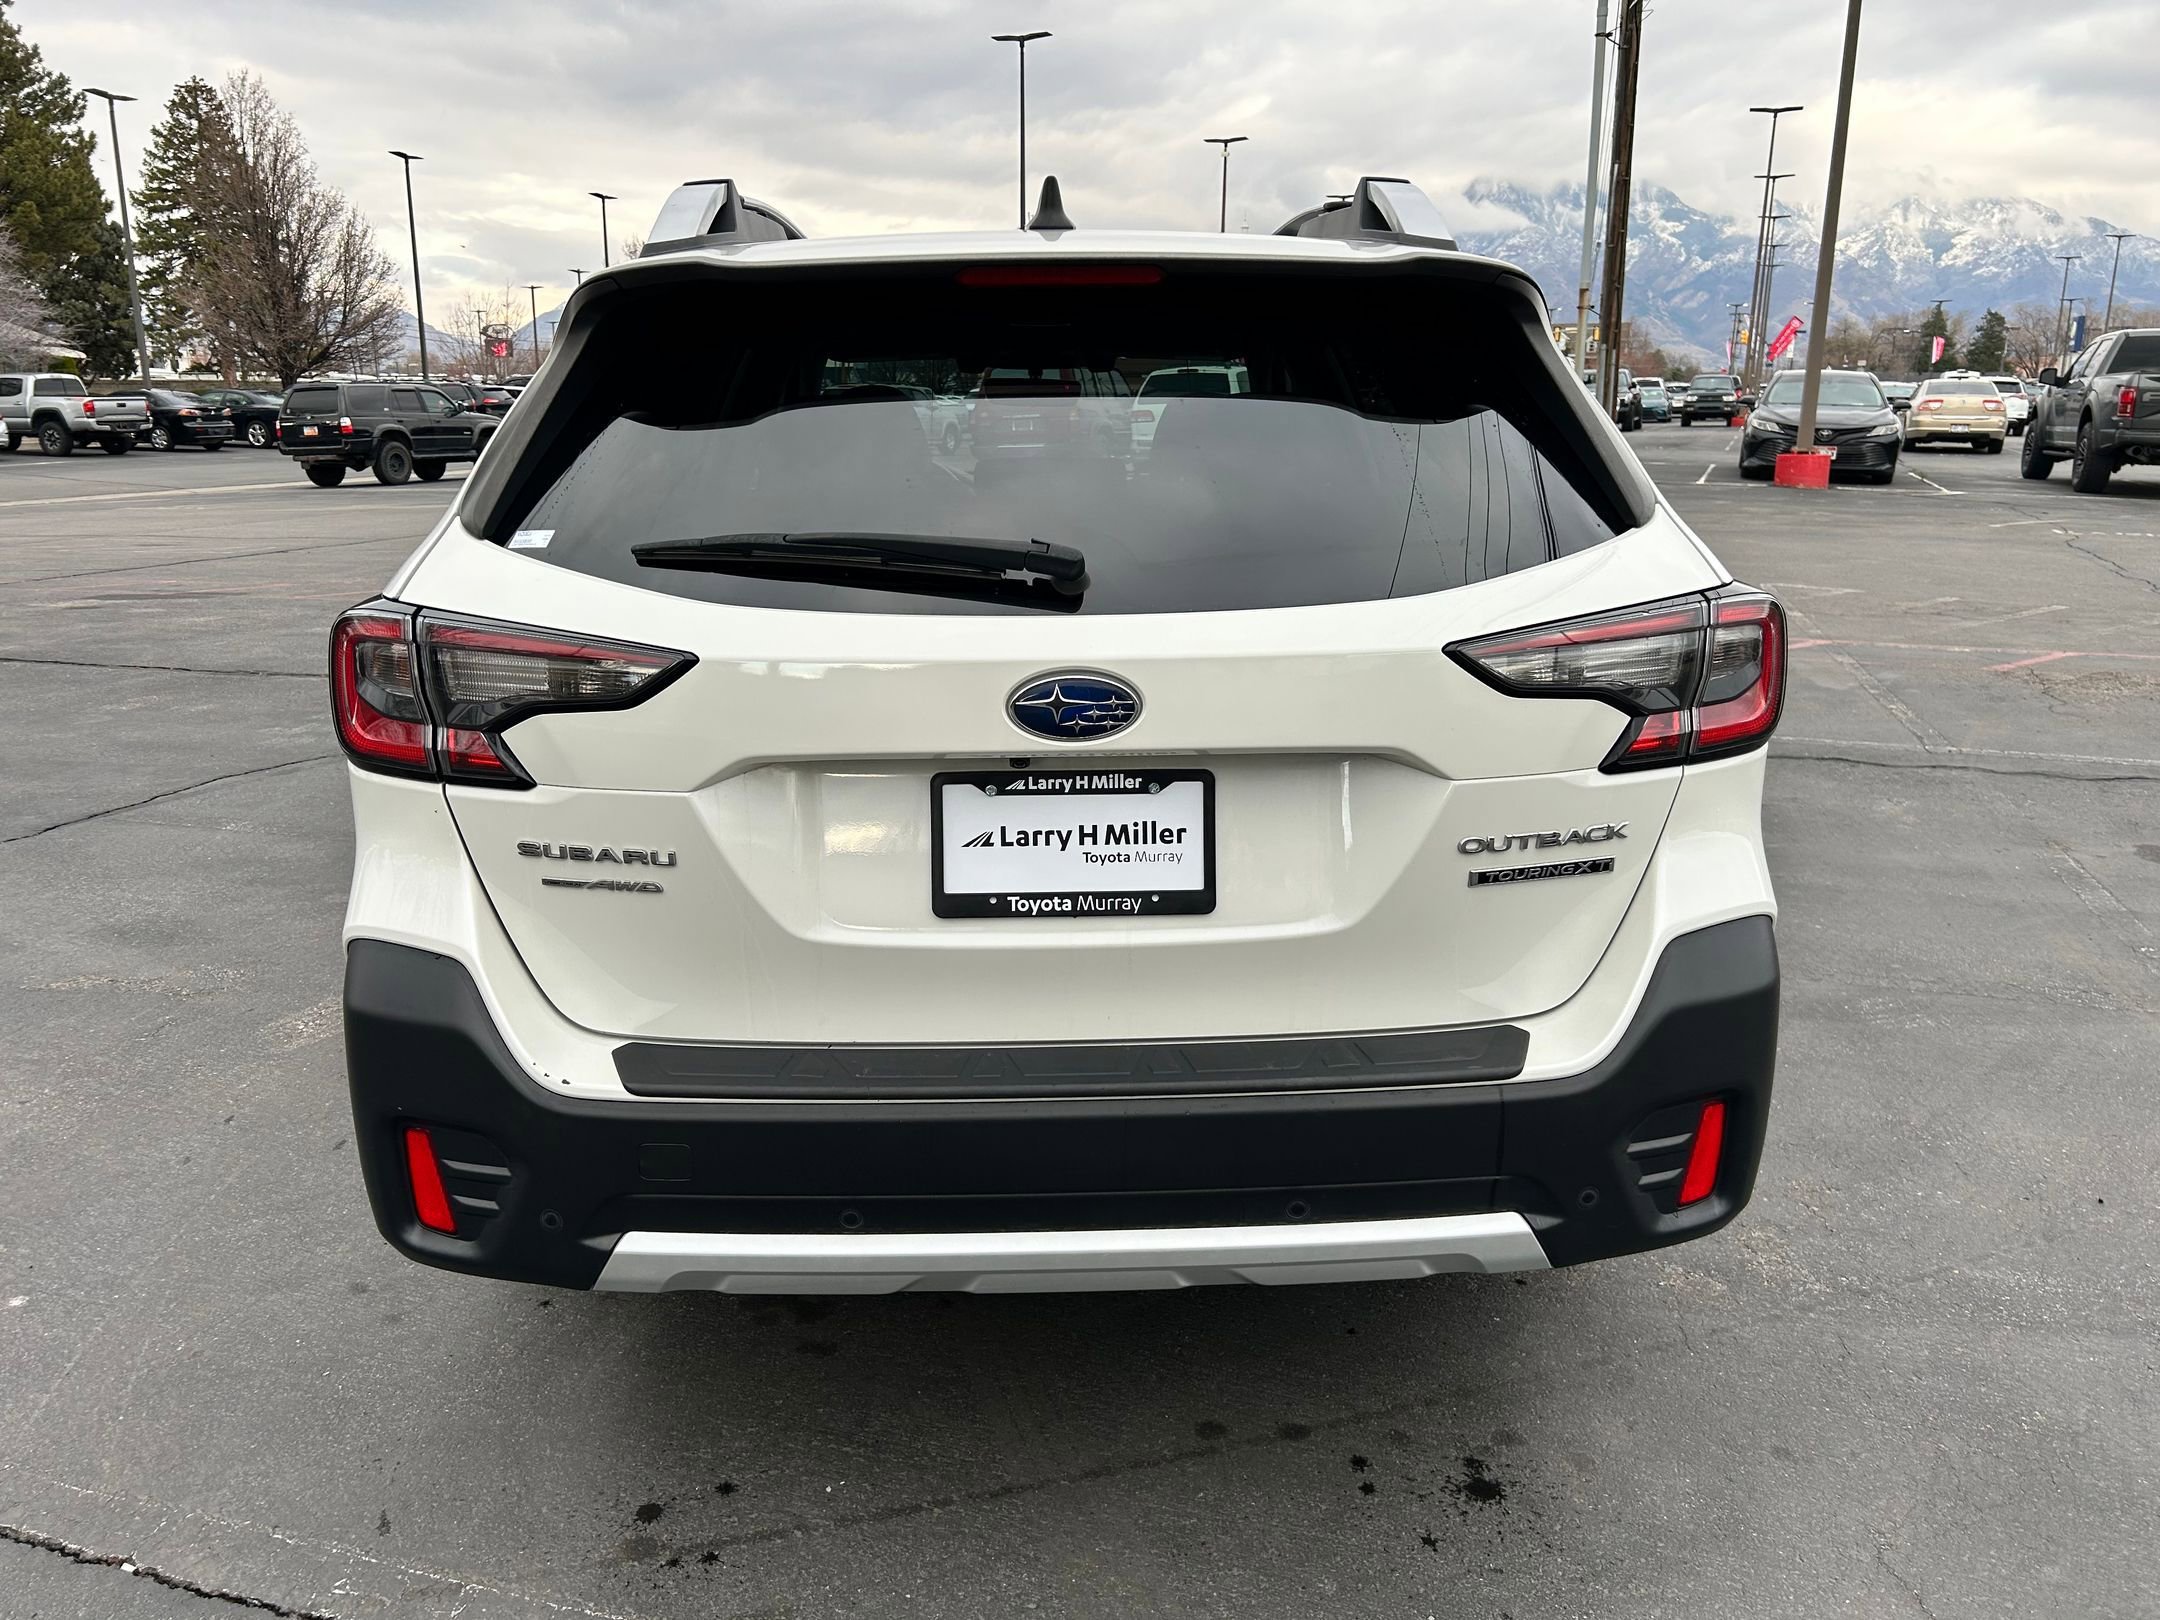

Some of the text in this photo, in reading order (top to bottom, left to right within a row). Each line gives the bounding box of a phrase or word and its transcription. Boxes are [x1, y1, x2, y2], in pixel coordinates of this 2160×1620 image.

[1028, 774, 1142, 792] Larry H Miller
[1000, 821, 1187, 851] Larry H Miller
[1457, 821, 1630, 854] OUTBACK
[516, 840, 677, 867] SUBARU
[1082, 851, 1183, 866] Toyota Murray
[585, 879, 664, 893] AWD
[1007, 894, 1142, 915] Toyota Murray
